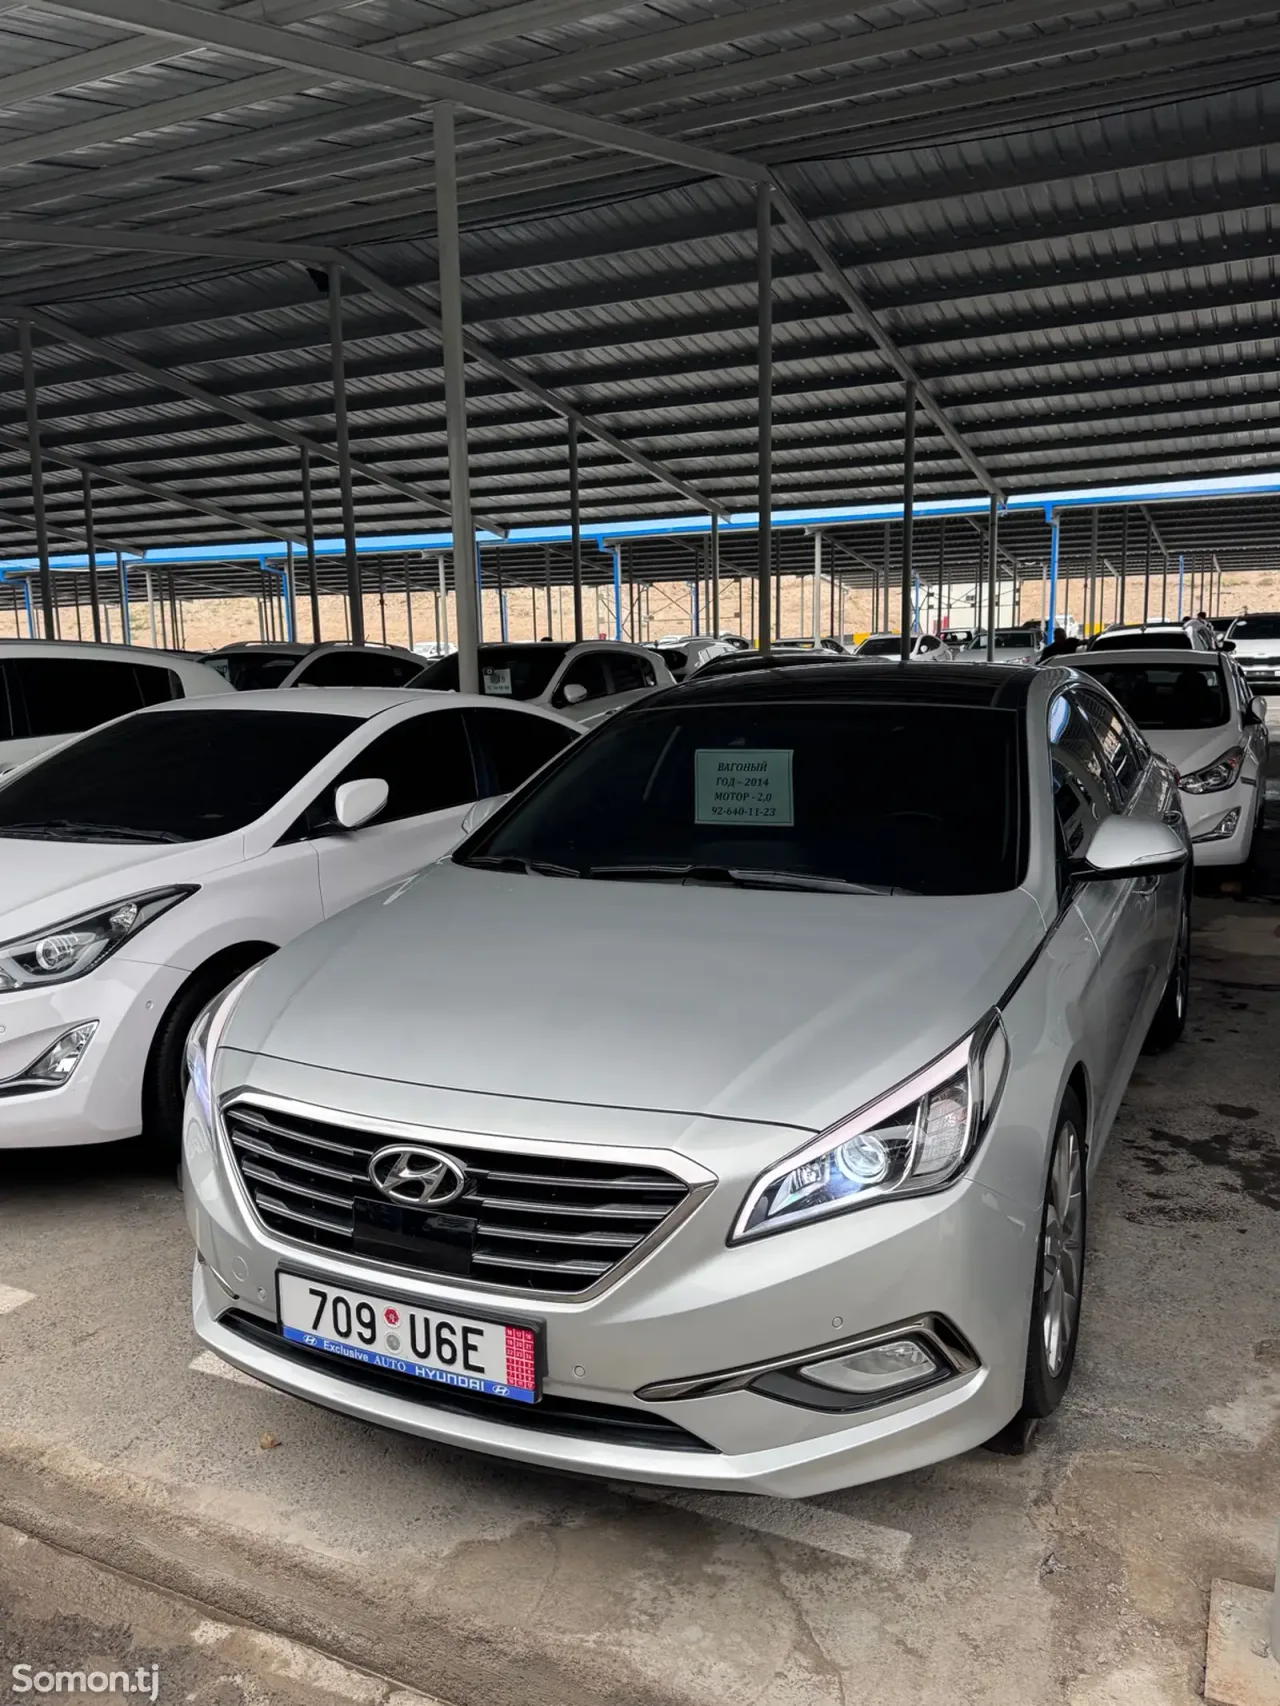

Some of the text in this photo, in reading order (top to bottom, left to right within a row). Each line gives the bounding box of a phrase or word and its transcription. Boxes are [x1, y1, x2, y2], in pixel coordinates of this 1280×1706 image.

[717, 761, 768, 772] ВАГОНЫЙ
[744, 778, 770, 787] 2014
[714, 792, 750, 802] МОТОР
[757, 792, 773, 802] 2,0
[711, 806, 777, 817] 92-640-11-23
[308, 1287, 377, 1346] 709
[409, 1313, 485, 1374] U6E
[323, 1340, 369, 1362] Exclusive
[373, 1355, 407, 1372] AUTO
[415, 1366, 485, 1392] HYUNDAI
